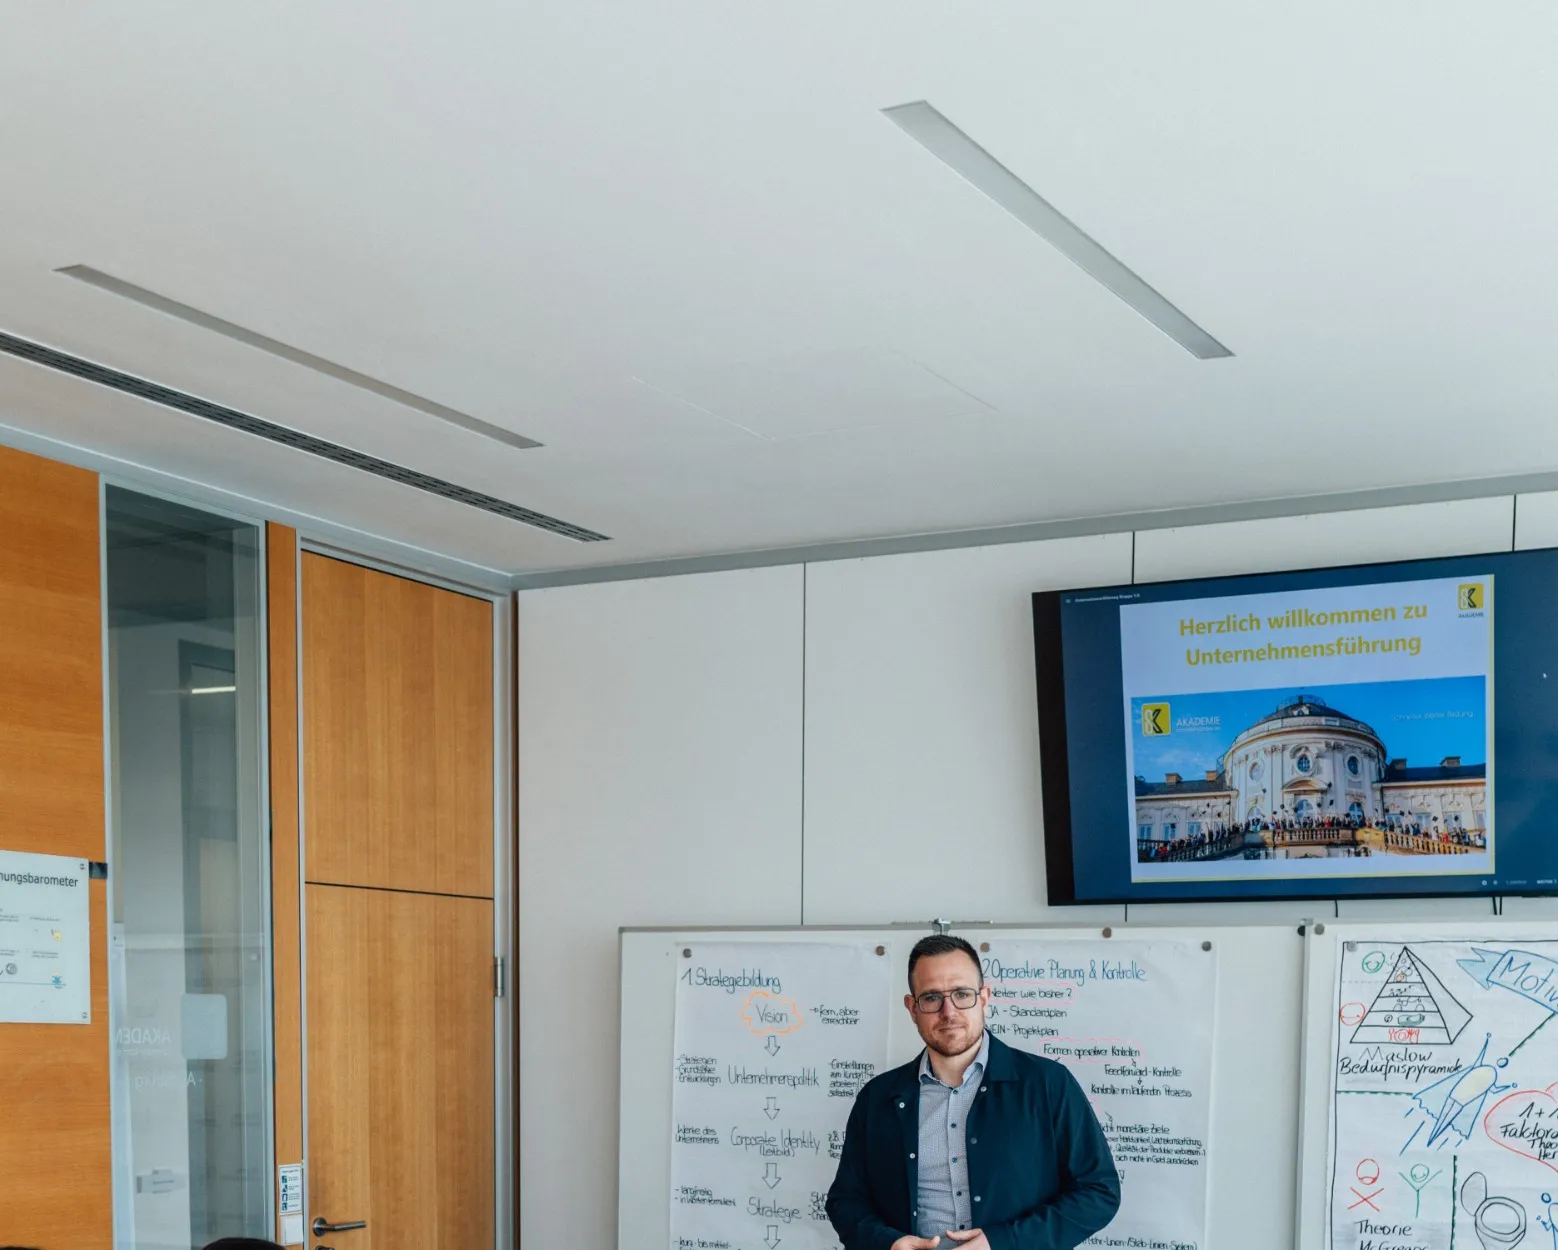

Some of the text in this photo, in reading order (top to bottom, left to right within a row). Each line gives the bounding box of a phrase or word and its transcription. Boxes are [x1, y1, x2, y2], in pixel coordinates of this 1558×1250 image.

[1179, 604, 1428, 636] Herzlich willkommen zu
[1185, 635, 1422, 666] Unternehmensführung
[1176, 716, 1222, 727] AKADEMIE
[695, 966, 782, 994] Strategiebildung
[991, 958, 1046, 983] Operative
[1049, 959, 1085, 986] Planung
[1089, 960, 1098, 980] &
[1102, 959, 1149, 981] Kontrolle
[1020, 989, 1037, 999] wie
[755, 1003, 788, 1024] Vision
[839, 1005, 860, 1017] aber
[1009, 1004, 1067, 1019] Standardplan
[1012, 1023, 1059, 1038] Projektplan
[1043, 1043, 1072, 1056] Formen
[1359, 1046, 1432, 1062] Maslow
[728, 1064, 820, 1088] Unternehmenspolitik
[1519, 1101, 1535, 1118] 1
[702, 1125, 717, 1136] des
[731, 1126, 776, 1151] Corporate
[780, 1128, 821, 1155] Identity
[746, 1195, 802, 1224] Strategie
[1354, 1219, 1412, 1236] Theorie
